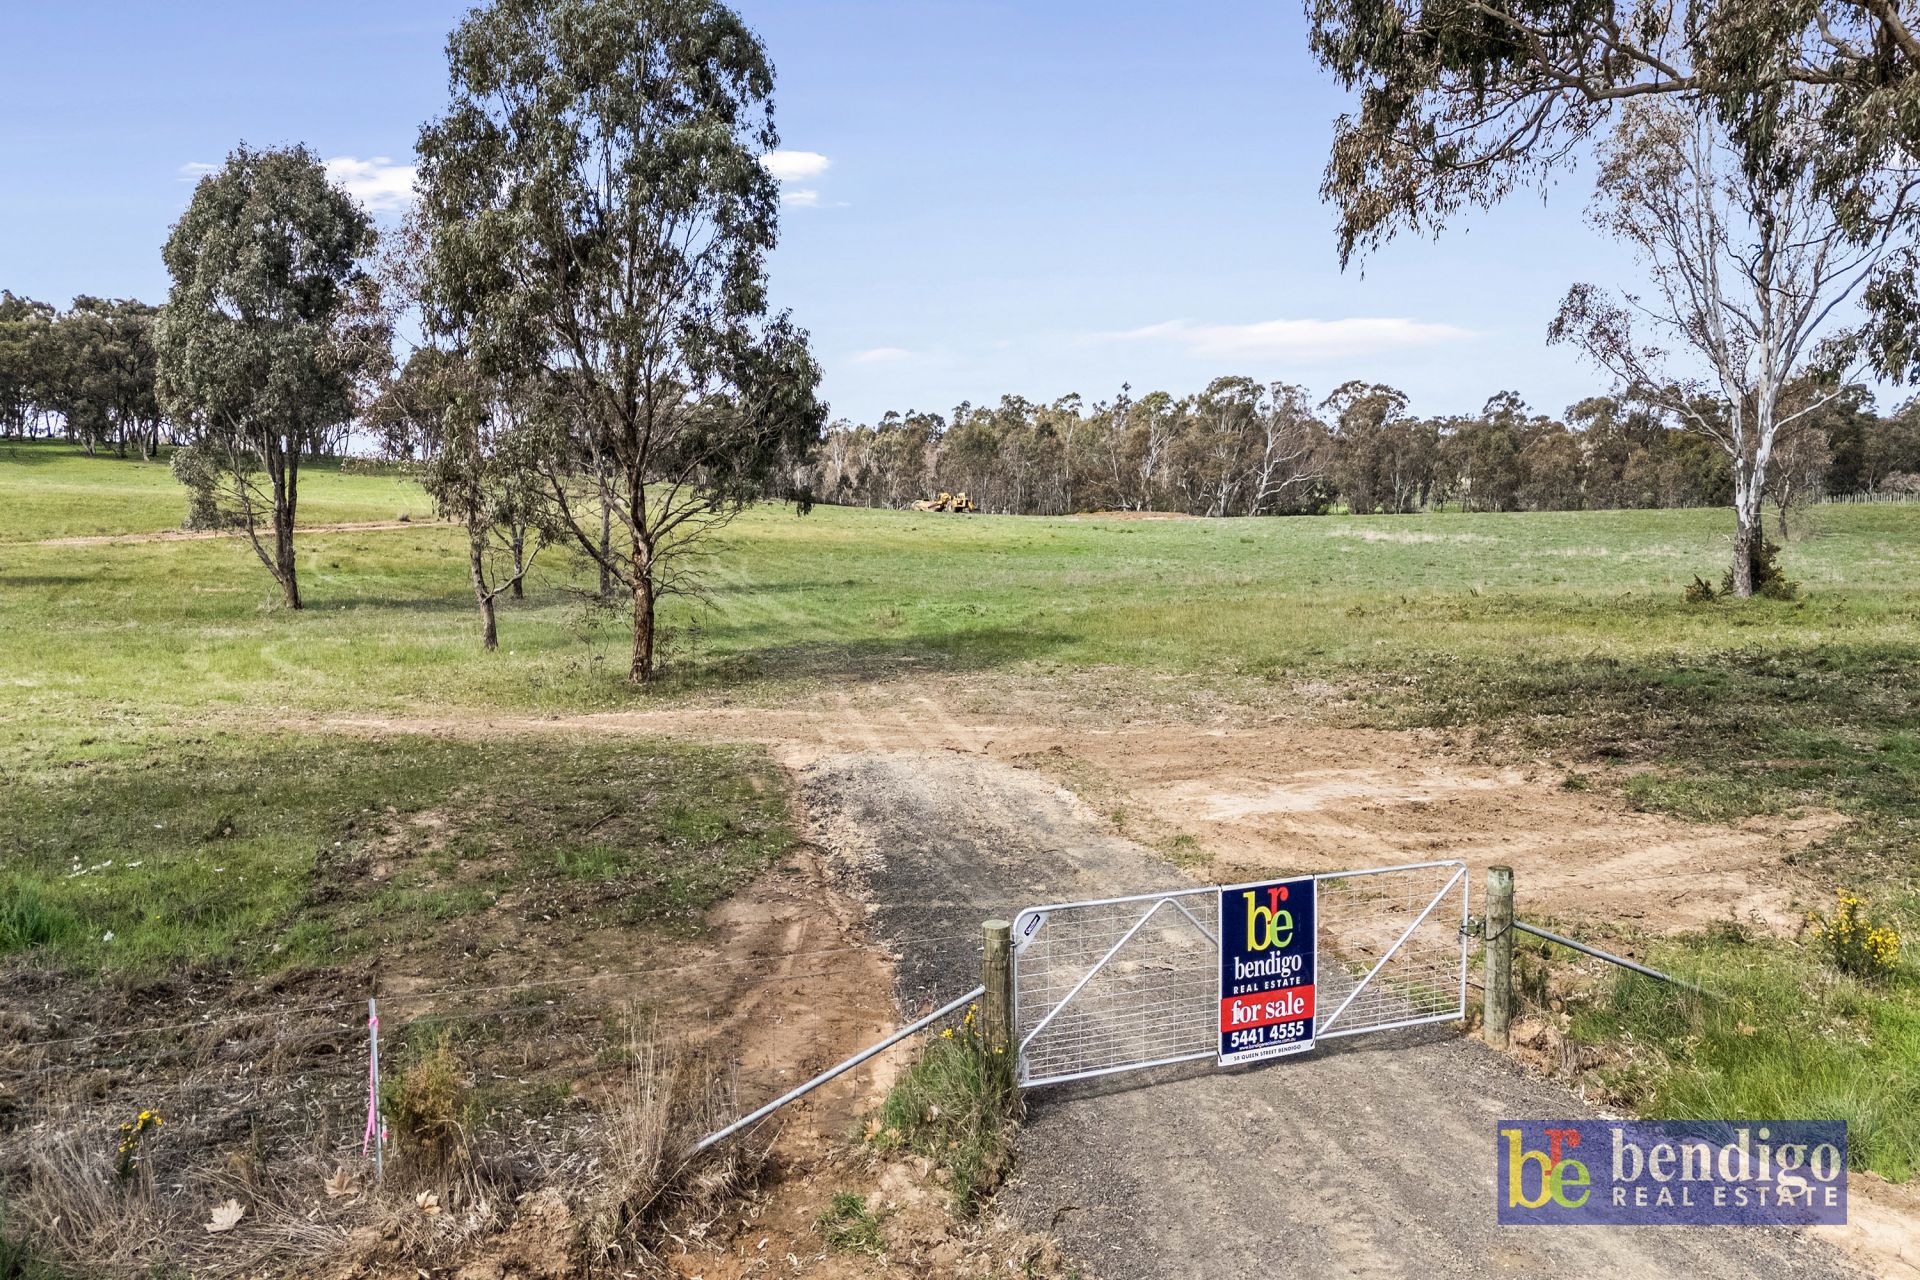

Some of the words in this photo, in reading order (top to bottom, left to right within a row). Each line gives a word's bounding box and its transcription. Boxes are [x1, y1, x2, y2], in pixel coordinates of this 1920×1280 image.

[1234, 951, 1302, 980] bendigo
[1233, 984, 1259, 995] REAL
[1264, 977, 1301, 989] ESTATE
[1231, 999, 1262, 1025] for
[1265, 992, 1304, 1019] sale
[1231, 1028, 1263, 1048] 5441
[1269, 1021, 1304, 1041] 4555
[1241, 1052, 1259, 1060] QUEEN
[1260, 1048, 1277, 1057] STREET
[1278, 1044, 1302, 1055] BENDIGO
